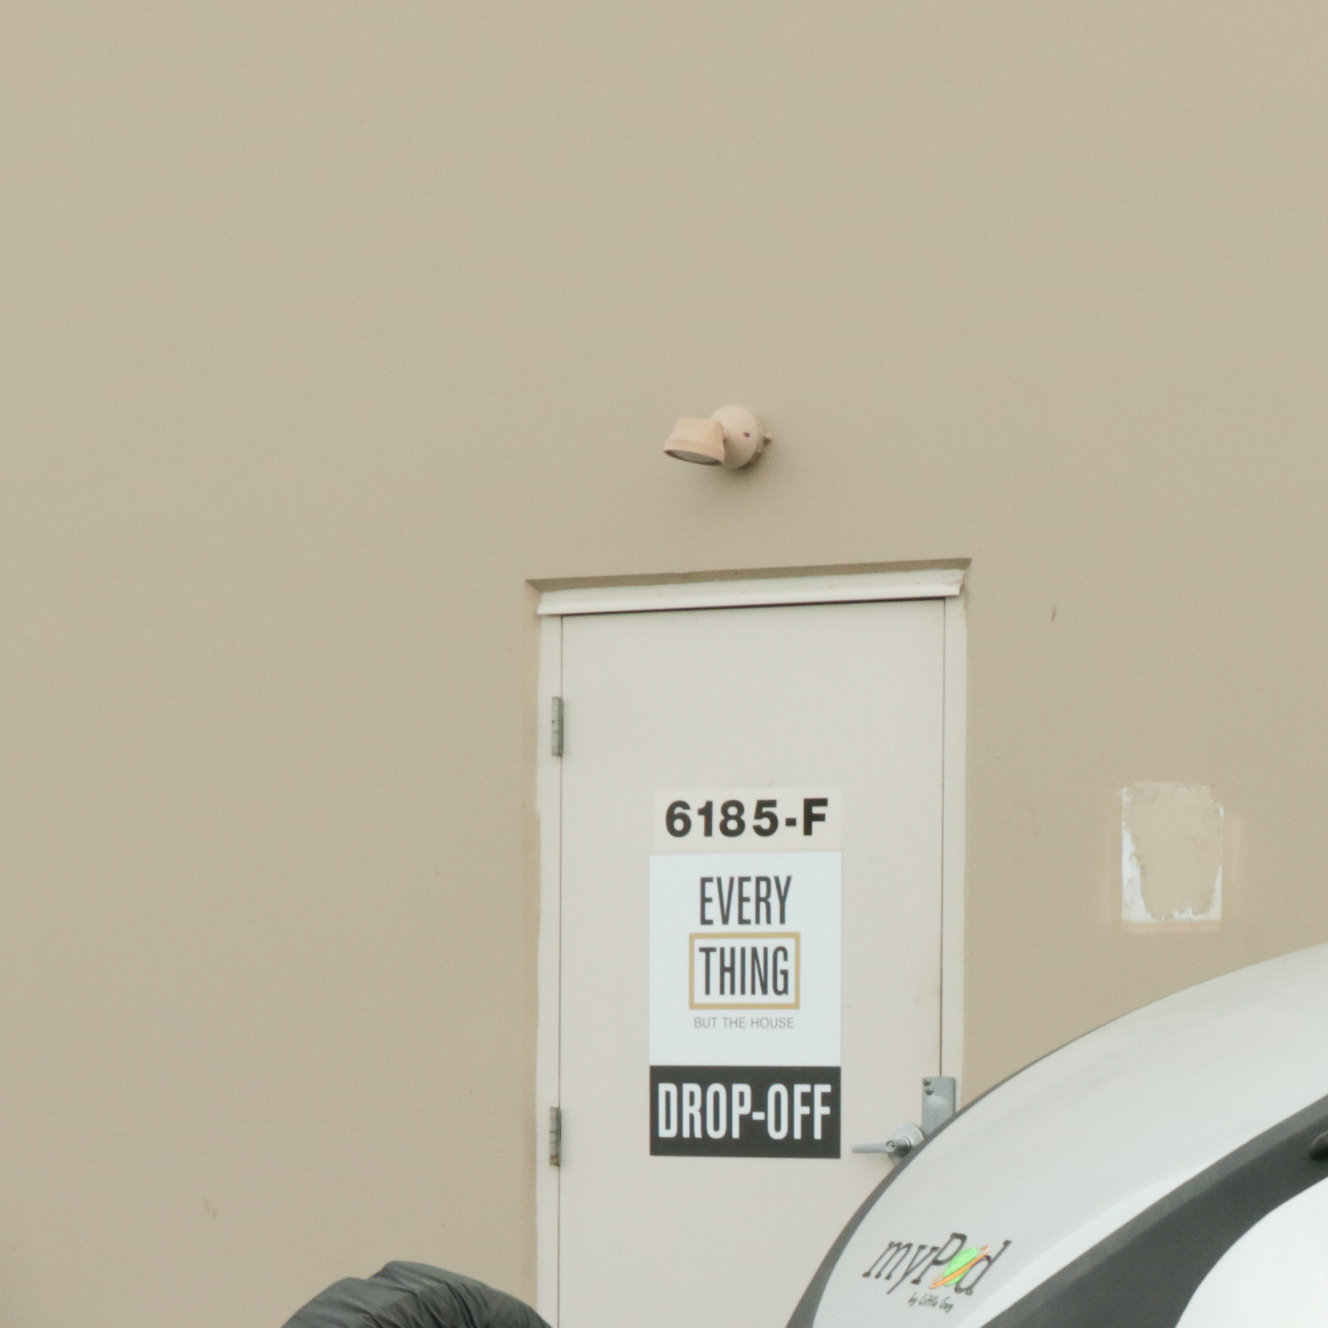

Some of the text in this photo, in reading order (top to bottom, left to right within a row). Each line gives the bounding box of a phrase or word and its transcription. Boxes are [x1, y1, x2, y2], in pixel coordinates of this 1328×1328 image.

[665, 797, 829, 838] 6185-F
[699, 875, 793, 926] EVERY
[698, 945, 790, 996] THING
[693, 1016, 795, 1029] BUT THE HOUSE
[657, 1082, 832, 1141] DROP-OFF
